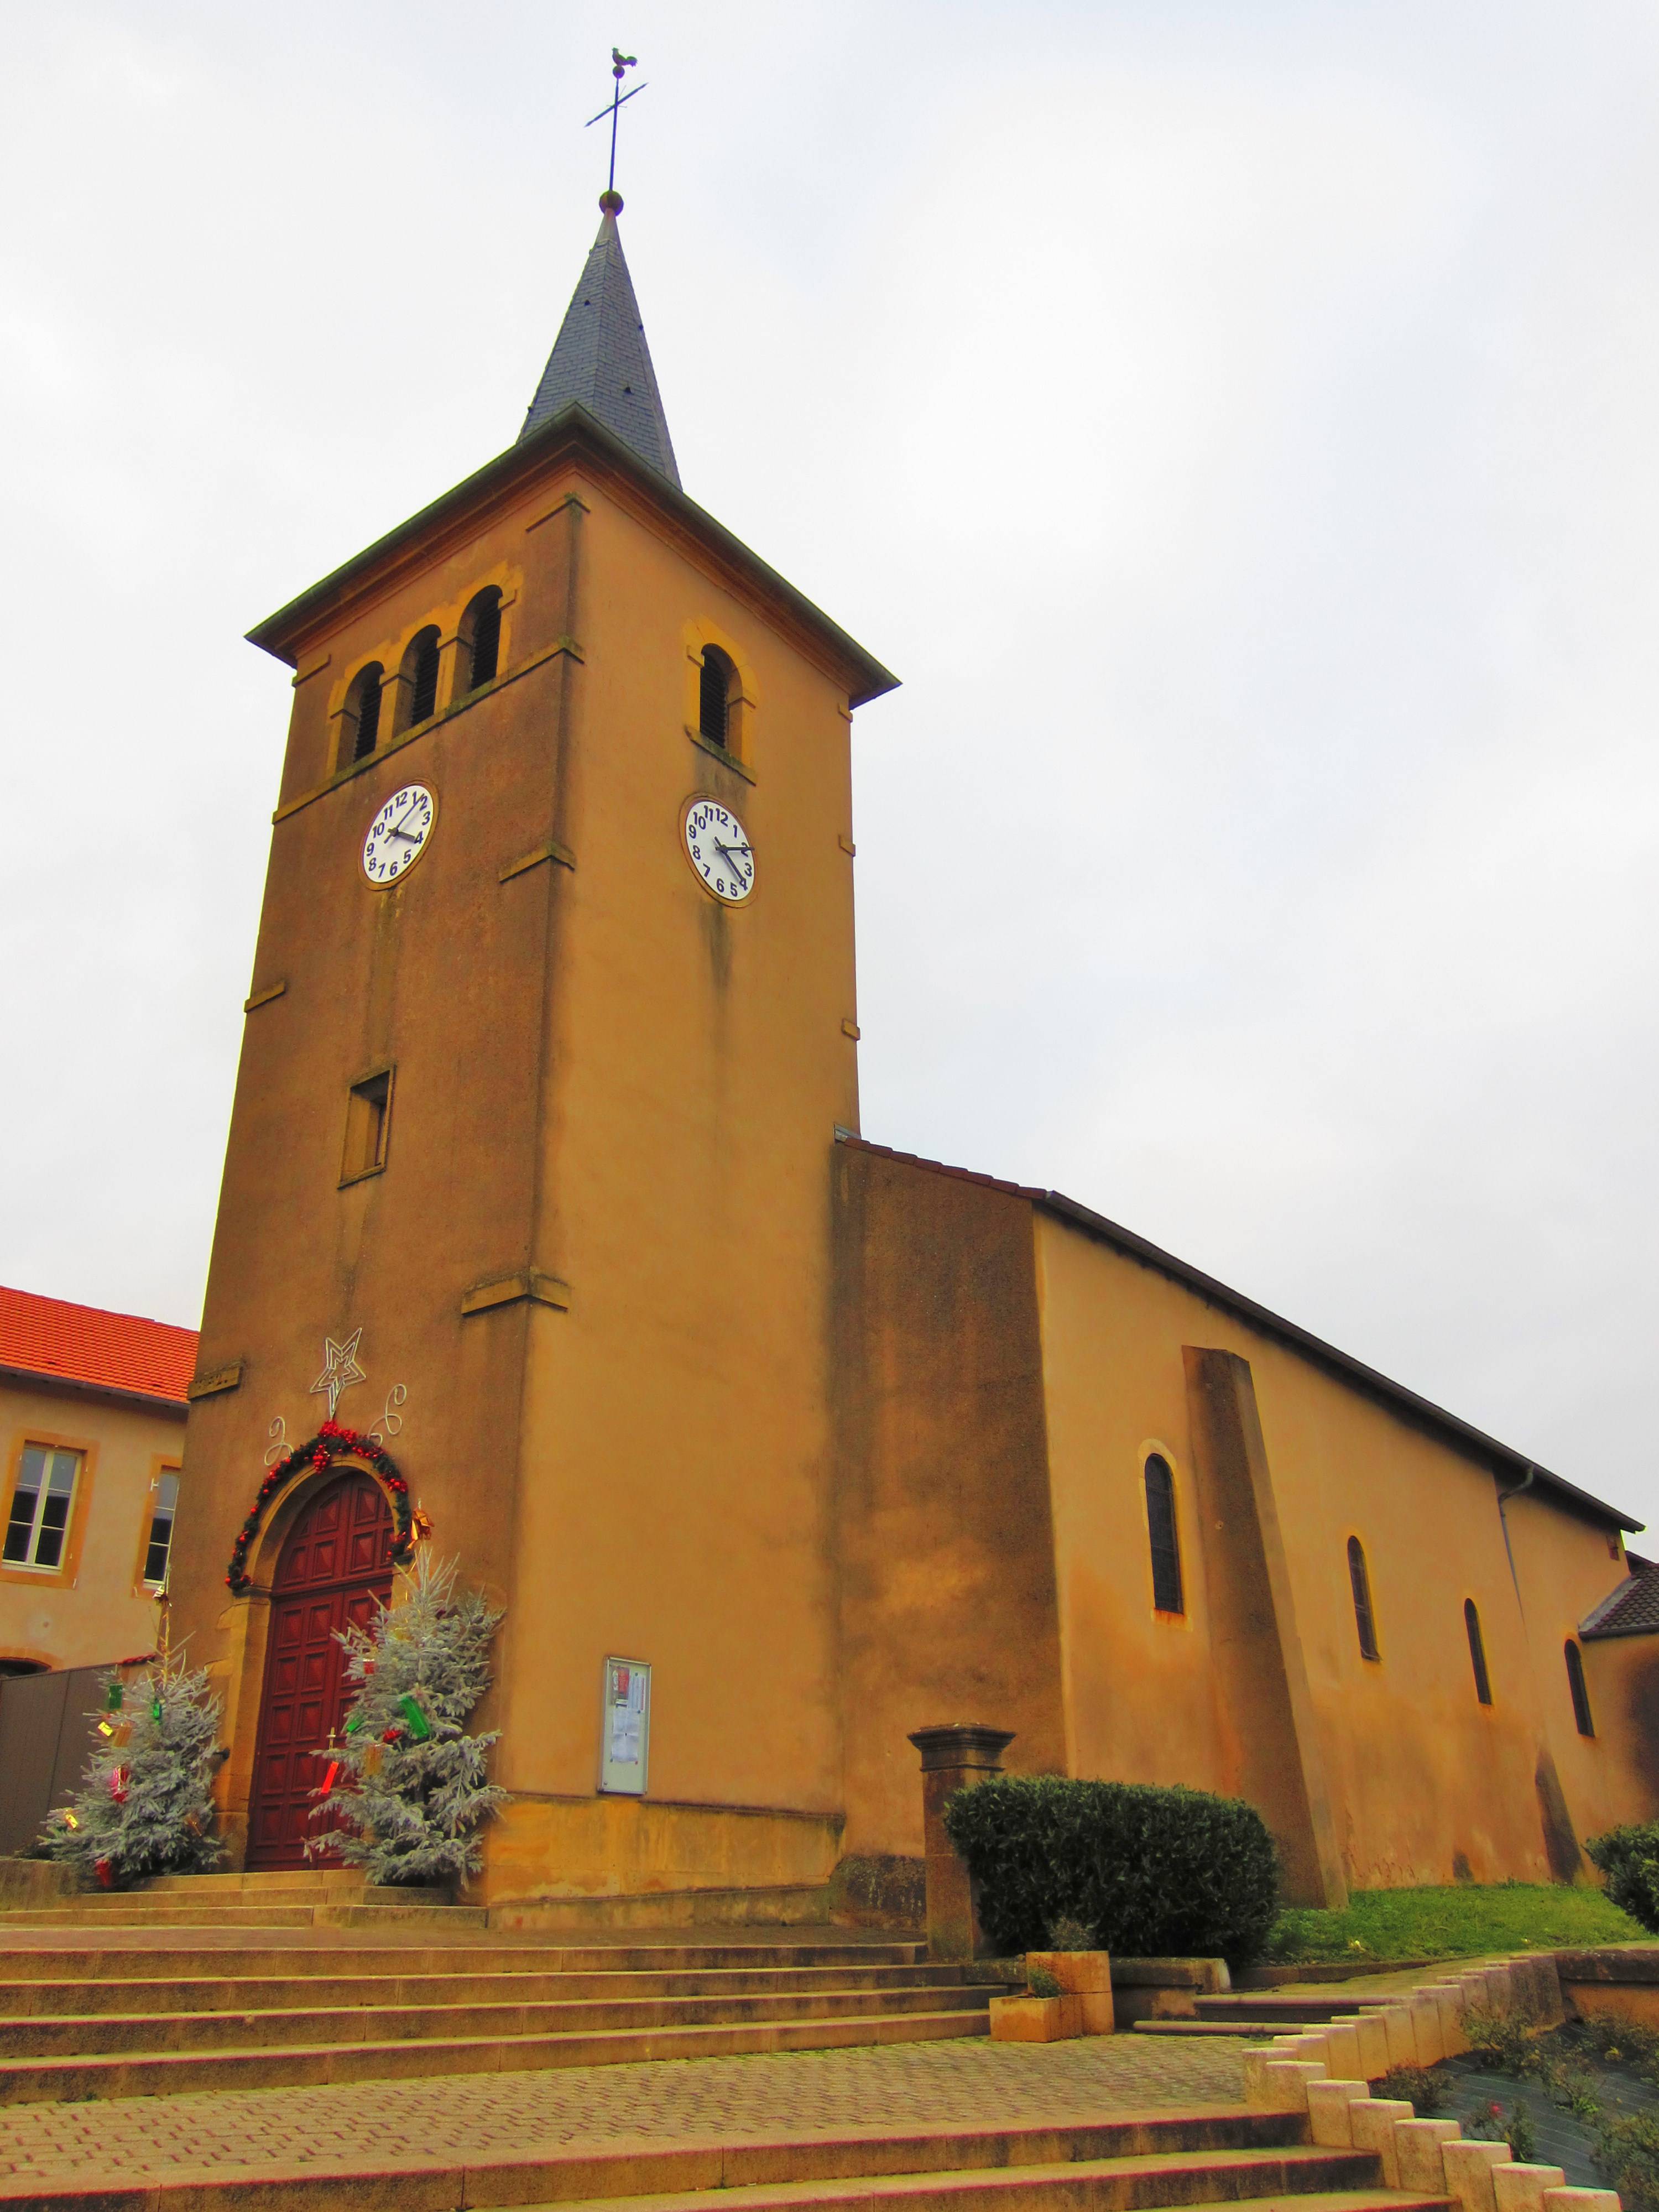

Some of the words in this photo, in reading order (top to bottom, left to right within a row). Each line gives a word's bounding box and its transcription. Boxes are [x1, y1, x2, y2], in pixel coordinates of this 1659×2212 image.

[395, 791, 408, 808] 12
[412, 791, 417, 805] 1
[419, 795, 427, 811] 2
[383, 805, 393, 820] 11
[421, 811, 431, 826] 3
[703, 805, 713, 822] 11
[716, 808, 729, 827] 12
[693, 811, 706, 830] 10
[372, 822, 385, 838] 10
[414, 831, 424, 844] 4
[688, 824, 697, 839] 9
[733, 825, 738, 838] 1
[366, 842, 374, 857] 9
[403, 849, 411, 864] 5
[692, 845, 701, 860] 8
[740, 842, 749, 857] 2
[368, 857, 377, 872] 8
[378, 862, 386, 878] 7
[389, 861, 398, 876] 6
[703, 863, 711, 878] 7
[744, 862, 753, 877] 3
[716, 878, 724, 893] 6
[730, 881, 738, 897] 5
[739, 878, 748, 891] 4
